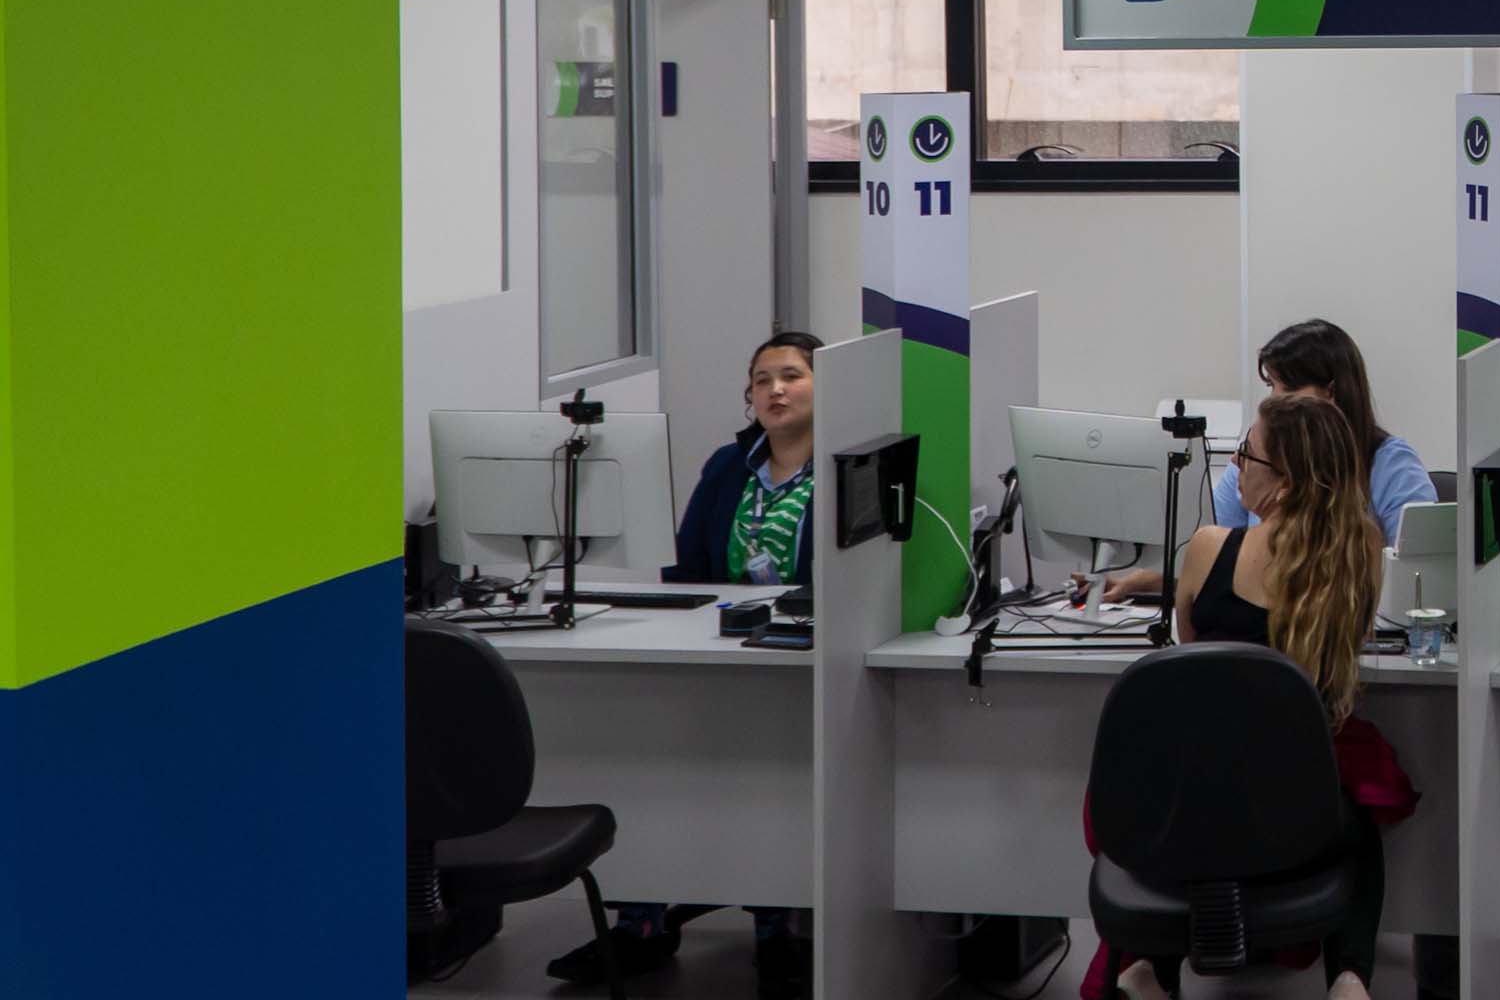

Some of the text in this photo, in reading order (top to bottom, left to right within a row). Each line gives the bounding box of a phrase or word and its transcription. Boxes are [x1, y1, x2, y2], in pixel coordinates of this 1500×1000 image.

[866, 181, 890, 216] 10
[914, 181, 952, 216] 11
[1466, 184, 1488, 222] 11
